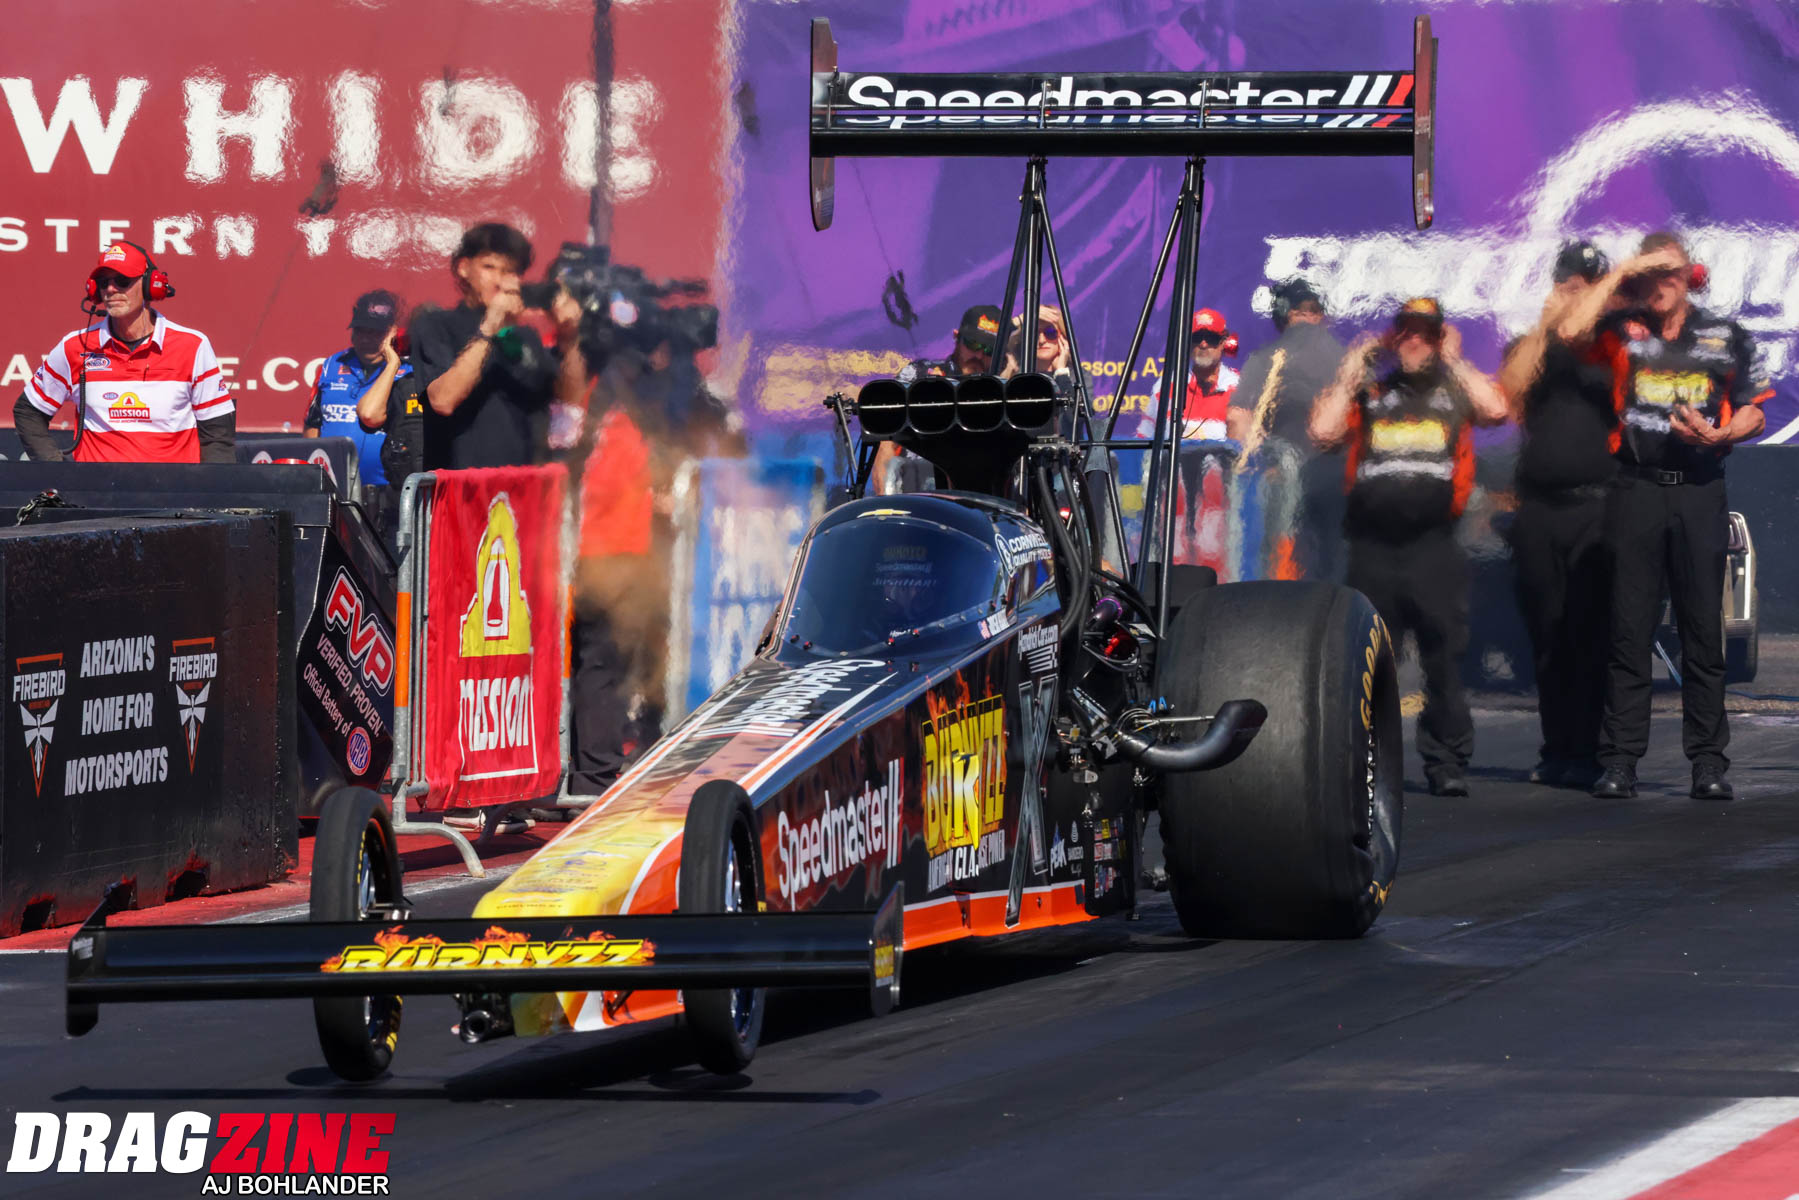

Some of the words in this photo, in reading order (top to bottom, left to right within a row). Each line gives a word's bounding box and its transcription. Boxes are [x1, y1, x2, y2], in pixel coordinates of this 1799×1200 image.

[845, 75, 1337, 129] Speedmaster
[0, 71, 657, 197] WHIDE
[80, 634, 155, 678] ARIZONA'S
[325, 570, 395, 693] FVP
[12, 669, 66, 702] FIREBIRD
[169, 652, 217, 682] FIREBIRD
[81, 695, 125, 735] HOME
[125, 692, 154, 729] FOR
[303, 663, 326, 701] Official
[321, 687, 345, 731] Battery
[341, 721, 353, 737] of
[350, 682, 383, 737] PROVEN.
[64, 746, 168, 796] MOTORSPORTS
[349, 733, 369, 769] NHRA
[777, 780, 888, 912] Speedmaster
